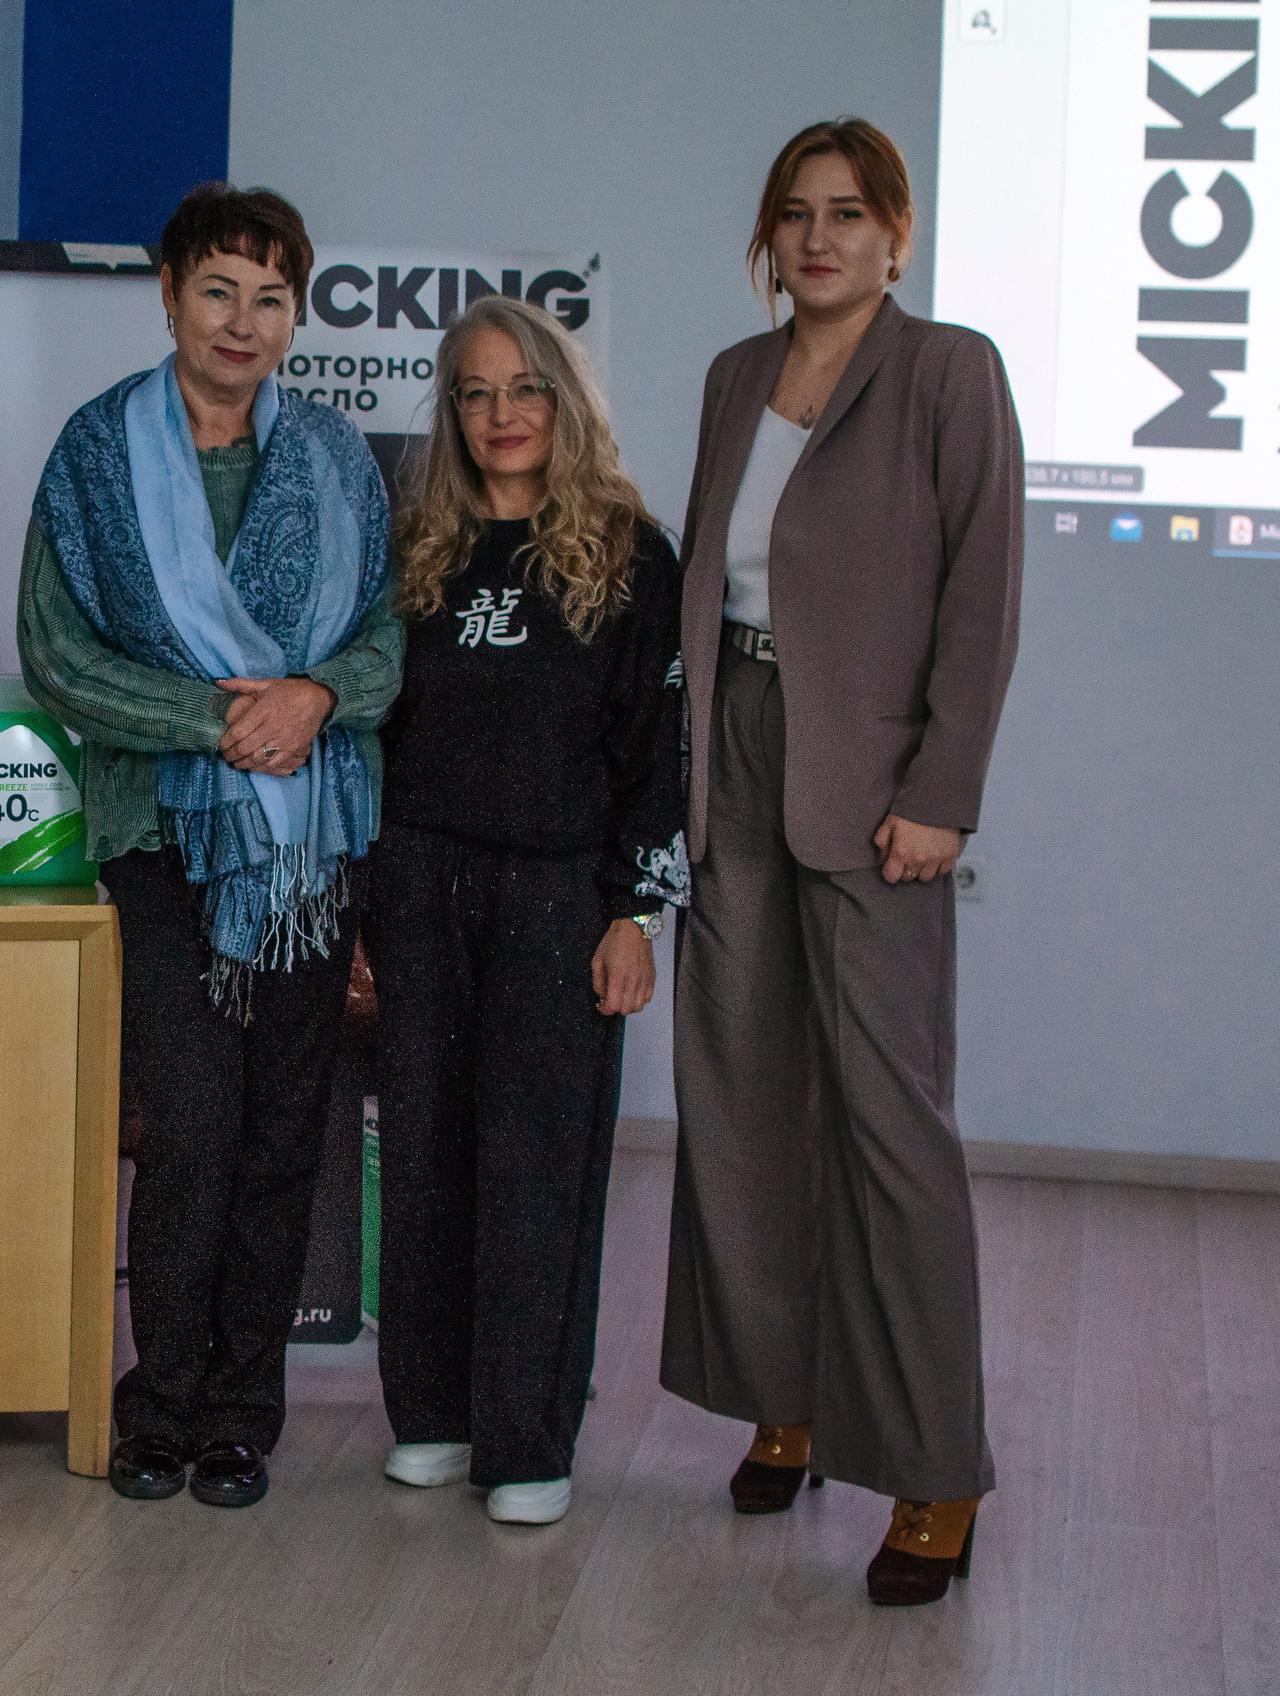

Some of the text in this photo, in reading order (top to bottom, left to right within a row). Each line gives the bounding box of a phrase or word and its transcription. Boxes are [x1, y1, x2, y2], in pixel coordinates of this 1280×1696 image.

[1132, 0, 1260, 450] MICKI
[278, 354, 434, 386] оторно
[455, 588, 528, 648] 龍
